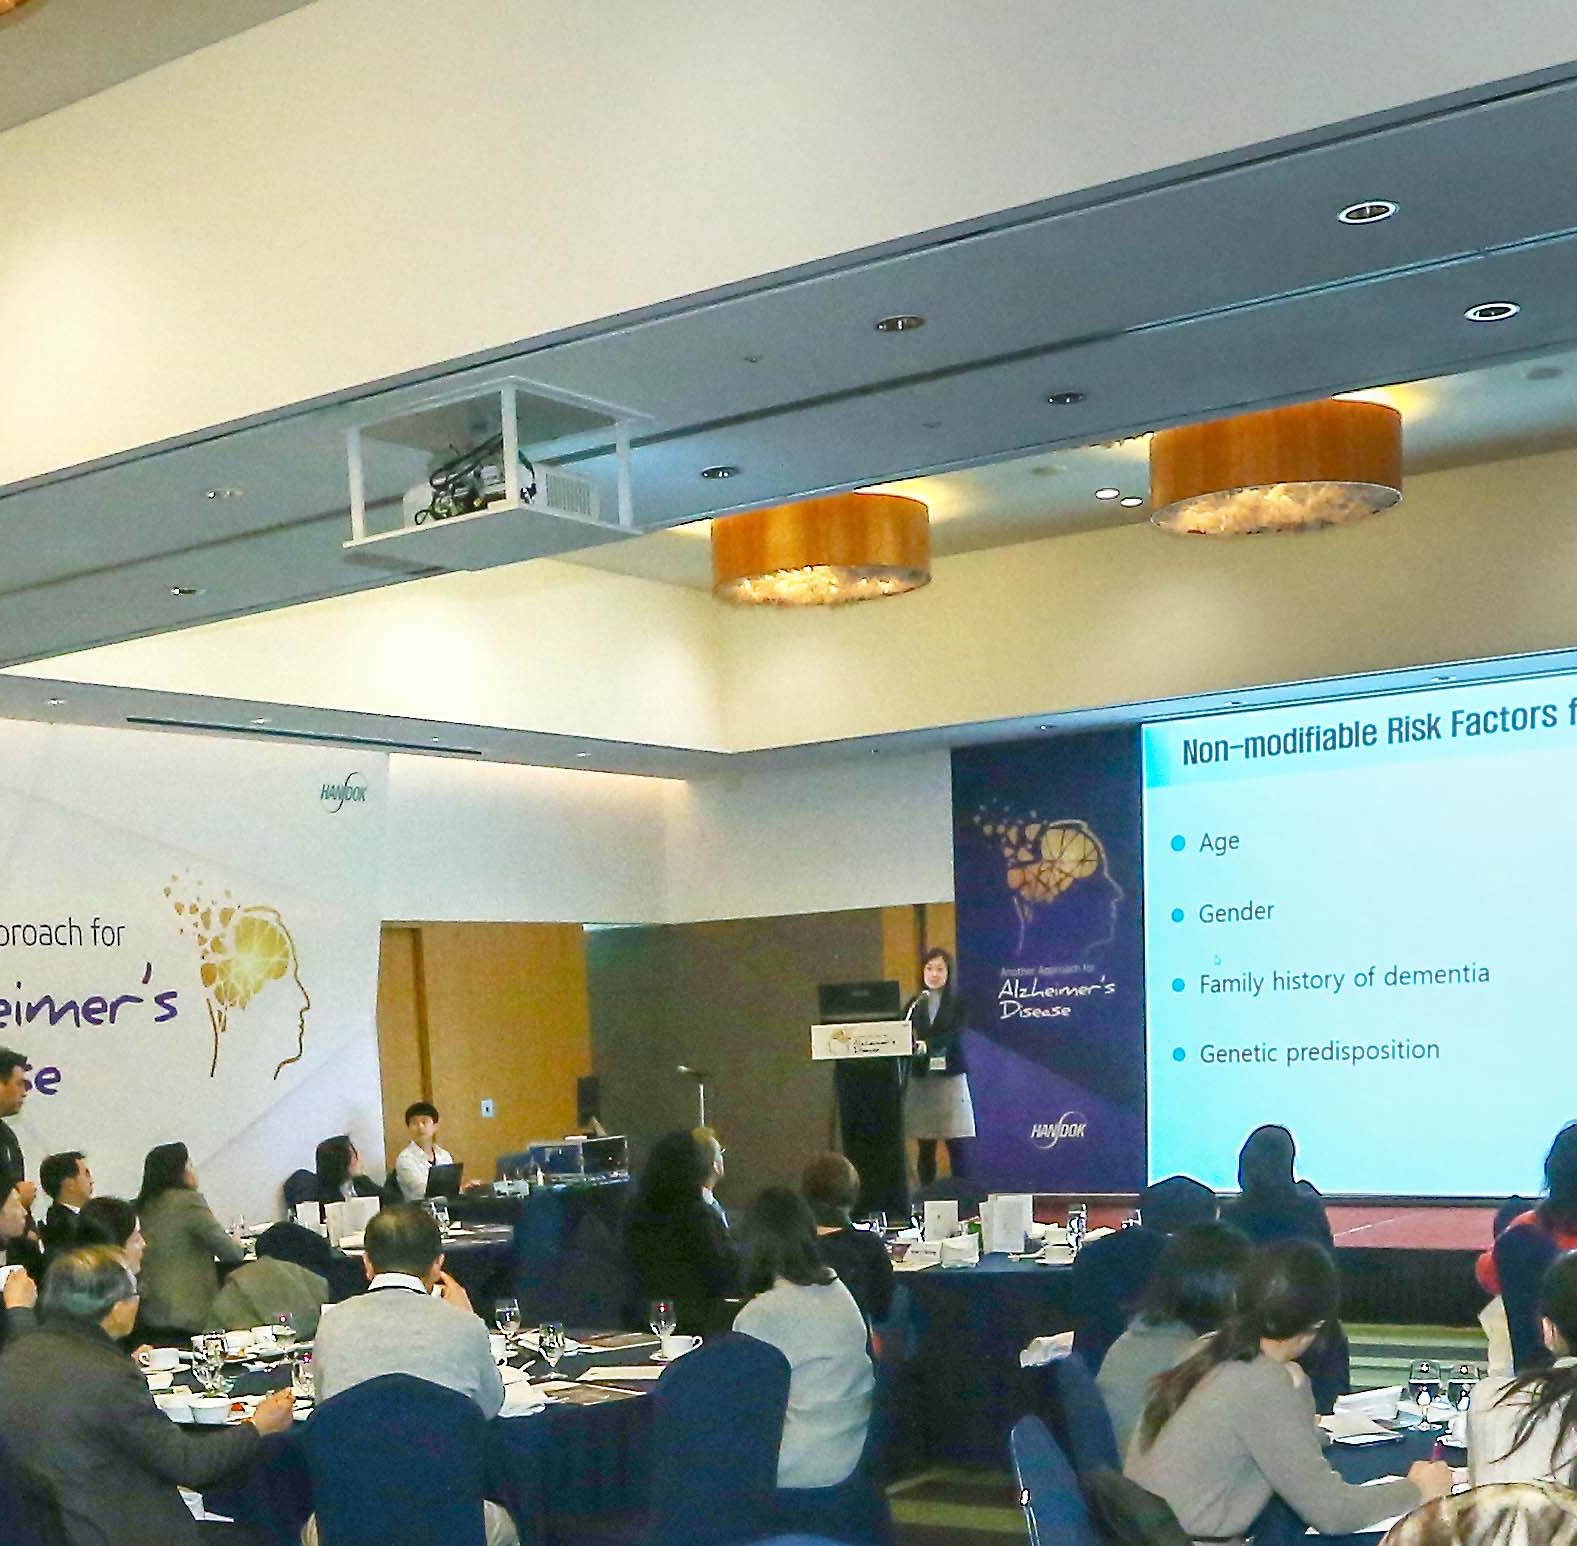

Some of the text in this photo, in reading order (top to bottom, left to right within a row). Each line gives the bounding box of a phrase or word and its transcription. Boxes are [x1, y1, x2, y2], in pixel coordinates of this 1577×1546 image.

[1182, 723, 1378, 766] Non-modifiable
[1387, 714, 1442, 744] Risk
[1450, 702, 1559, 739] Factors
[1199, 831, 1241, 856] Age
[1199, 900, 1275, 924] Gender
[91, 916, 126, 948] for
[998, 975, 1116, 999] Alzheimer's
[1200, 963, 1491, 998] Family history of dementia
[999, 1000, 1072, 1020] Disease
[1200, 1039, 1441, 1067] Genetic predisposition
